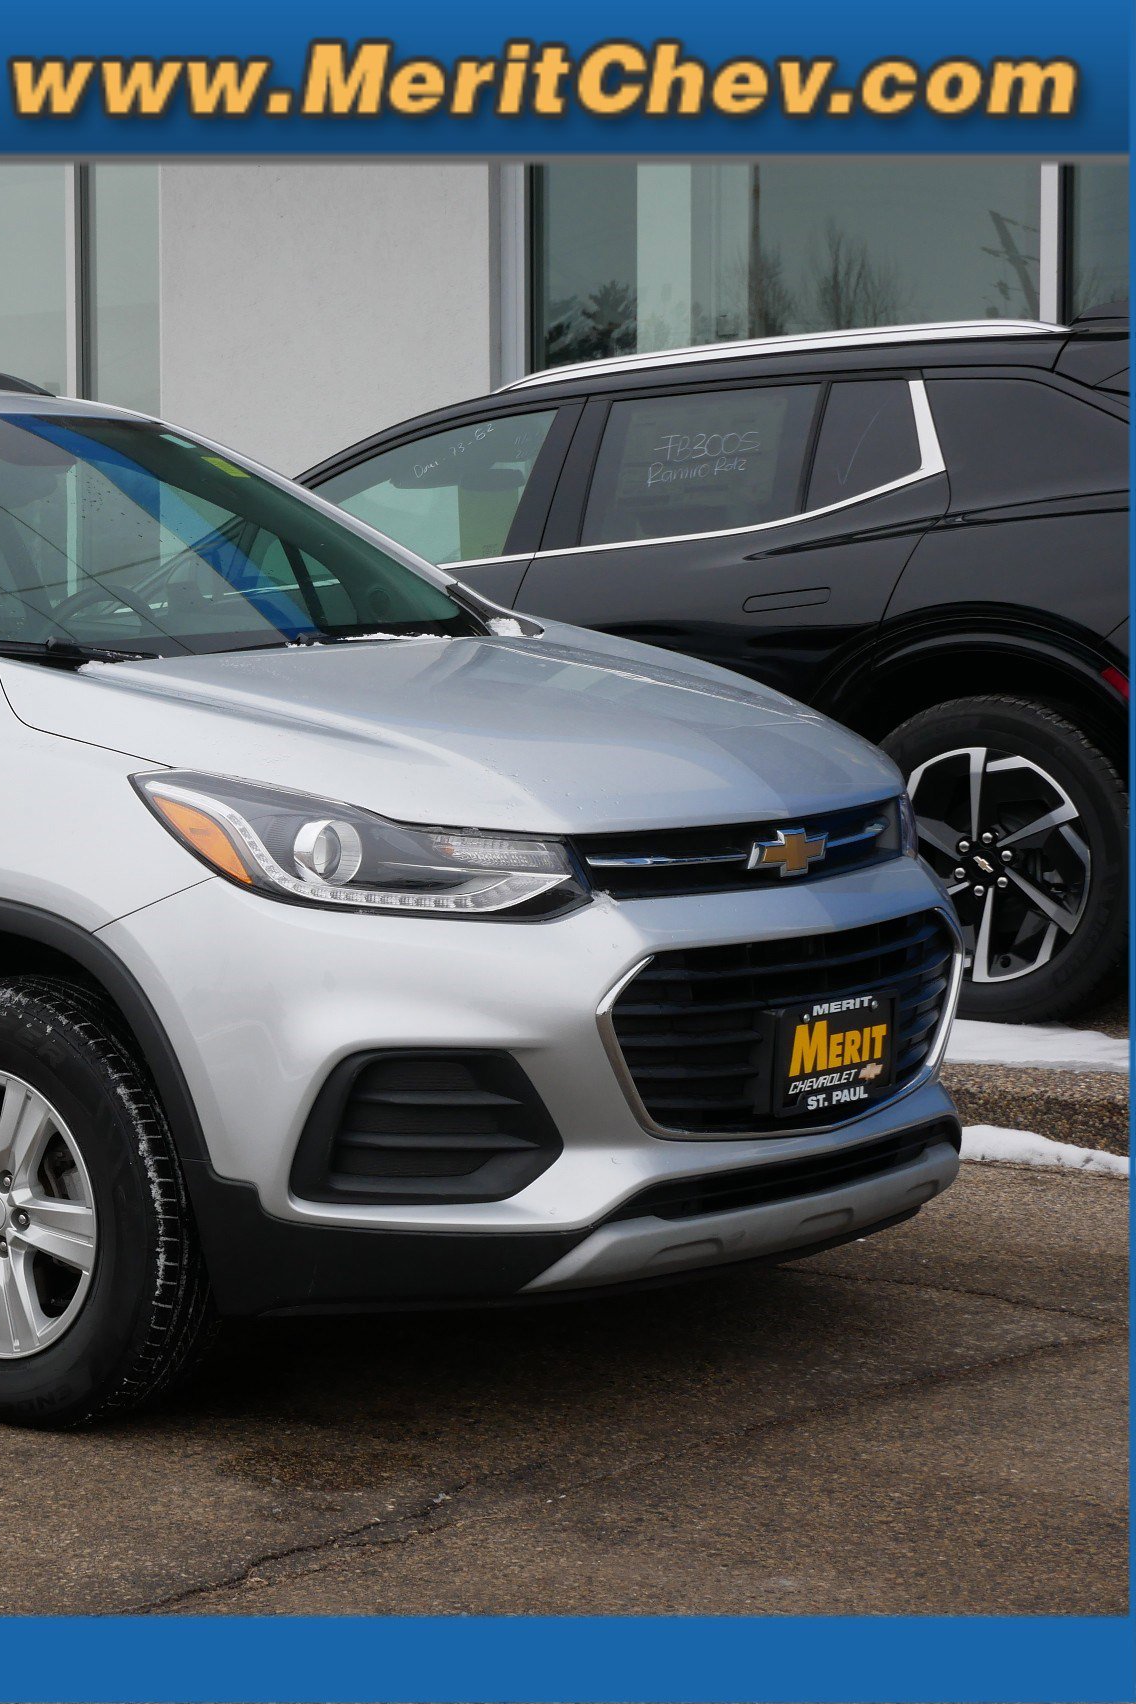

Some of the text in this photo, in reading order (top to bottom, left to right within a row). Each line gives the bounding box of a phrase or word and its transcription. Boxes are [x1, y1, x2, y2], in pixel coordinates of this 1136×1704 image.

[812, 995, 873, 1017] MERIT
[788, 1019, 887, 1078] MERIT
[788, 1069, 858, 1095] CHEVROLET
[807, 1085, 869, 1111] ST. PAUL
